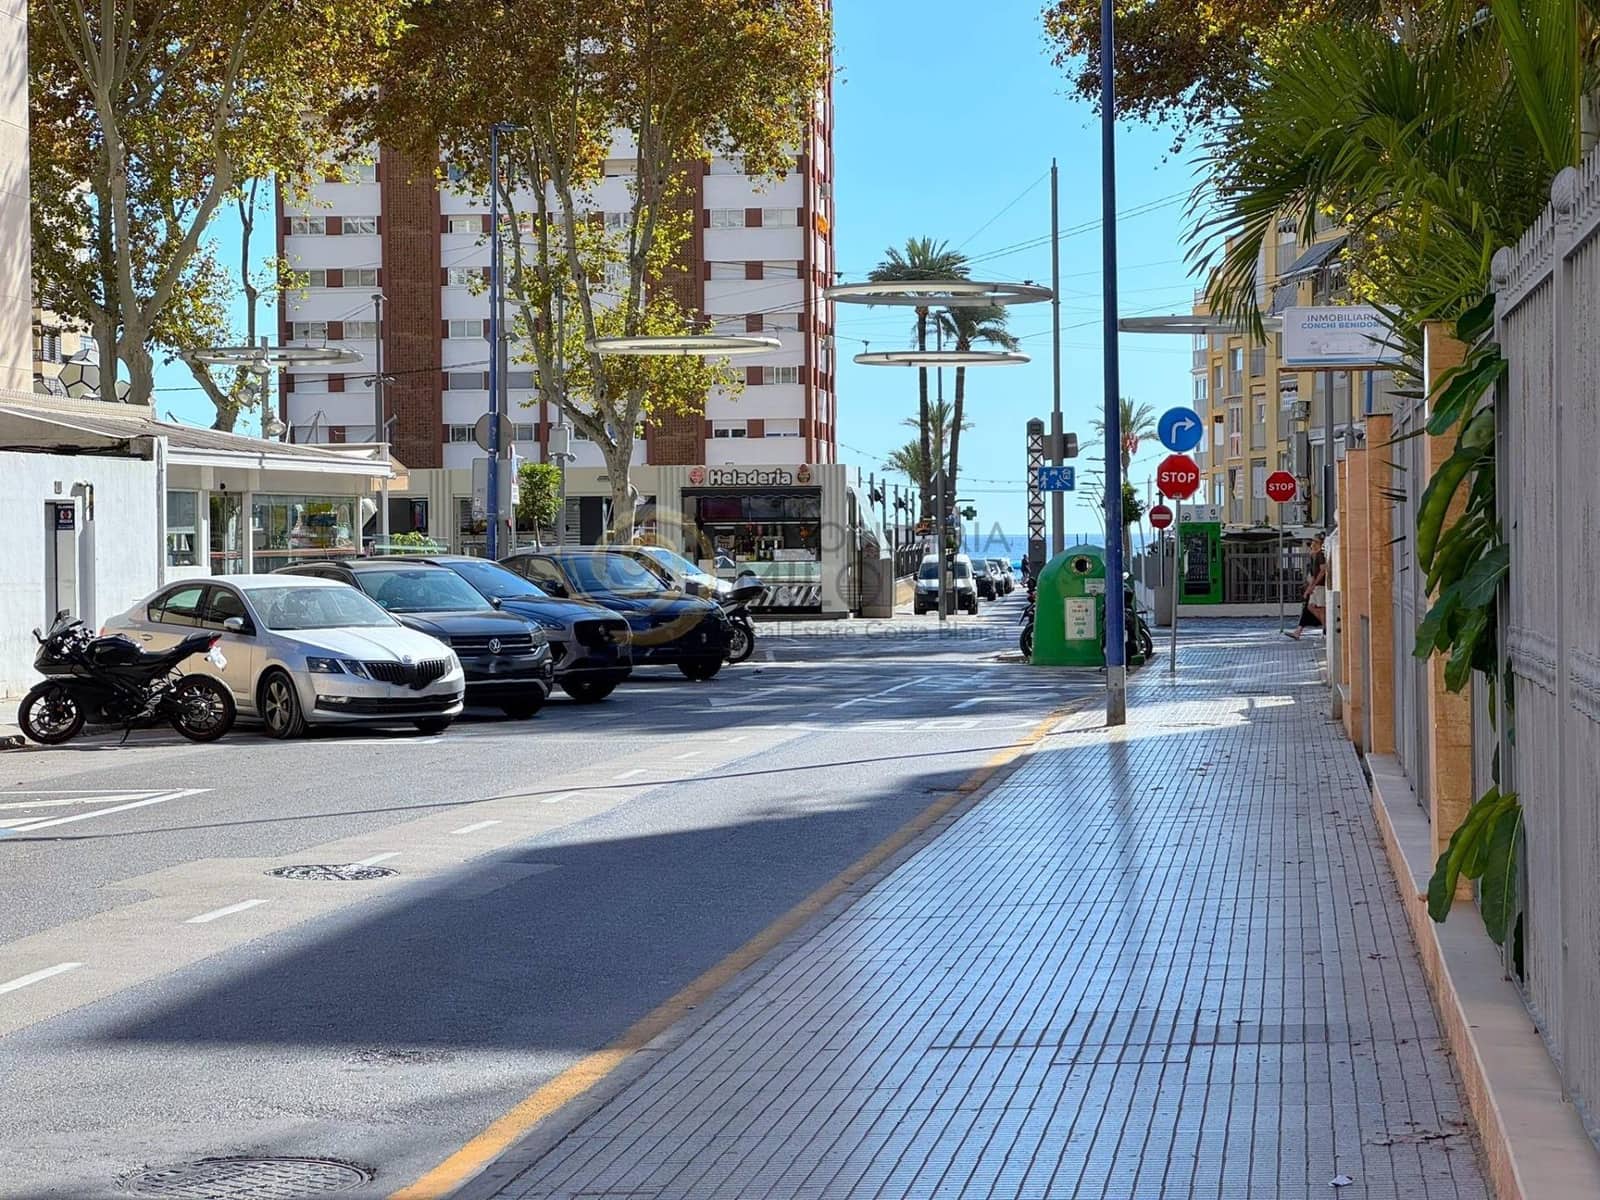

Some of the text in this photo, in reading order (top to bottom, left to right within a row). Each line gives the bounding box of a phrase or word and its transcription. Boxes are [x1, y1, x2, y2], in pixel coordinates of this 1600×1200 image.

[1307, 313, 1380, 322] INMOBILIARIA
[1301, 321, 1382, 329] CONCHI BENIDOR
[1161, 472, 1196, 483] STOP
[1268, 482, 1294, 492] STOP
